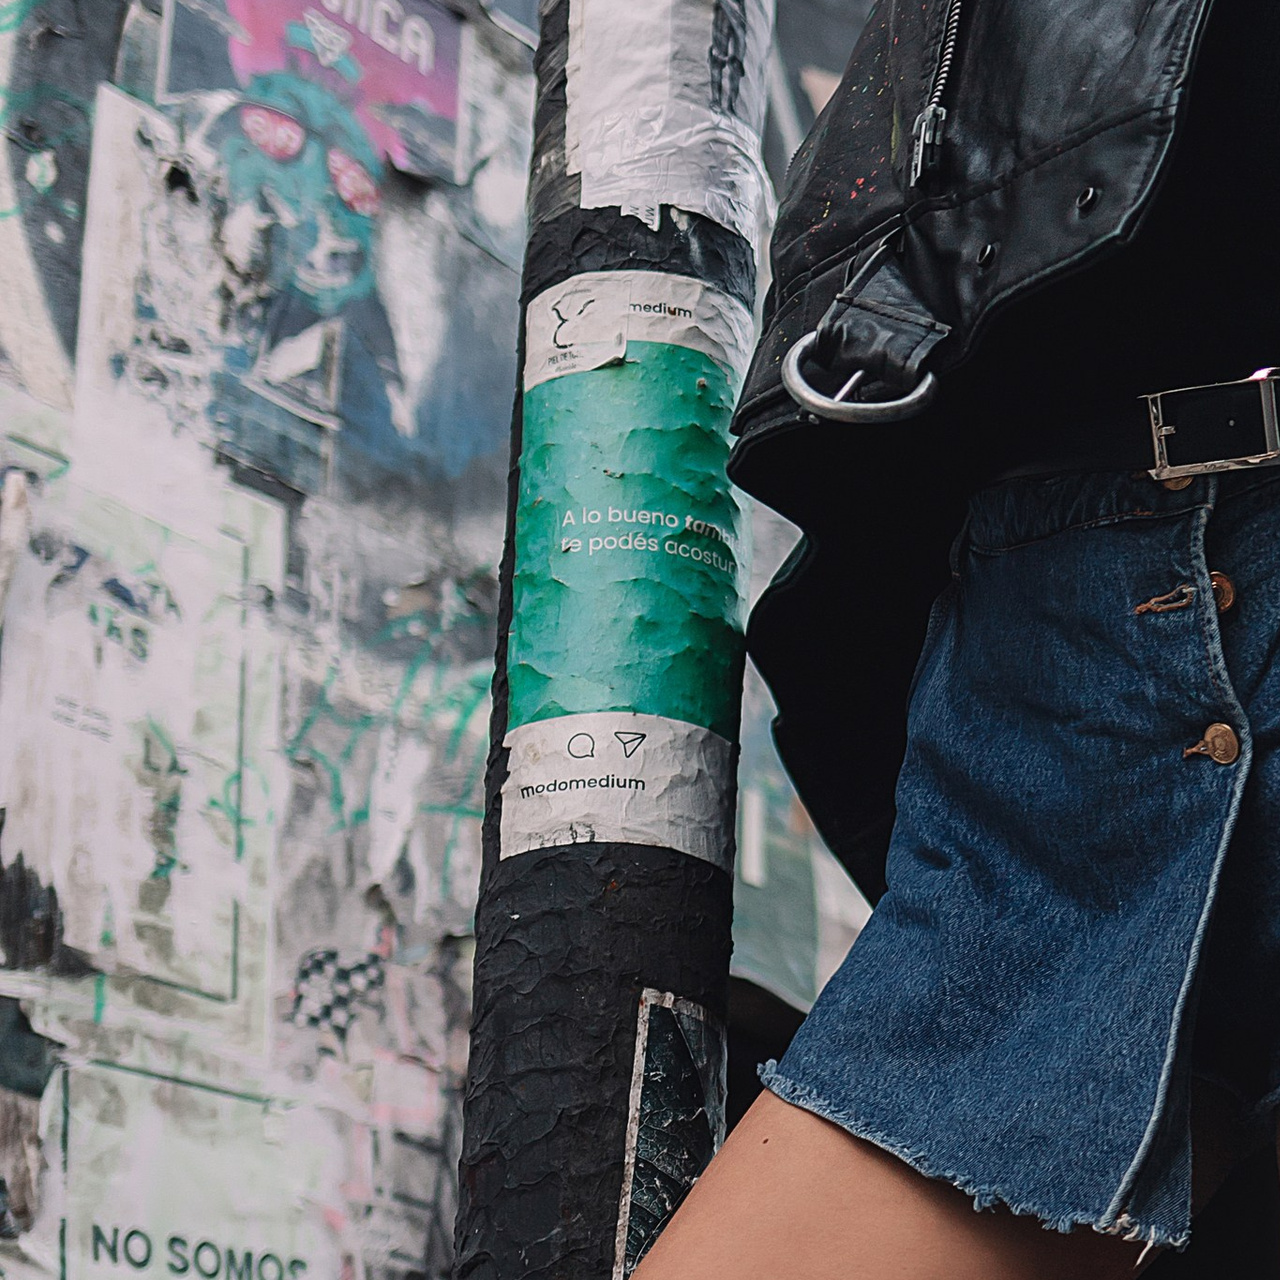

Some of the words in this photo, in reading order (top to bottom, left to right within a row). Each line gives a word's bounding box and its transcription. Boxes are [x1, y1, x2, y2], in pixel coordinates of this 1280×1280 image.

[562, 510, 576, 528] A
[582, 507, 601, 524] lo
[608, 506, 679, 528] bueno
[561, 537, 582, 553] te
[588, 532, 659, 556] podés
[520, 774, 646, 800] modomedium
[92, 1224, 152, 1269] NO
